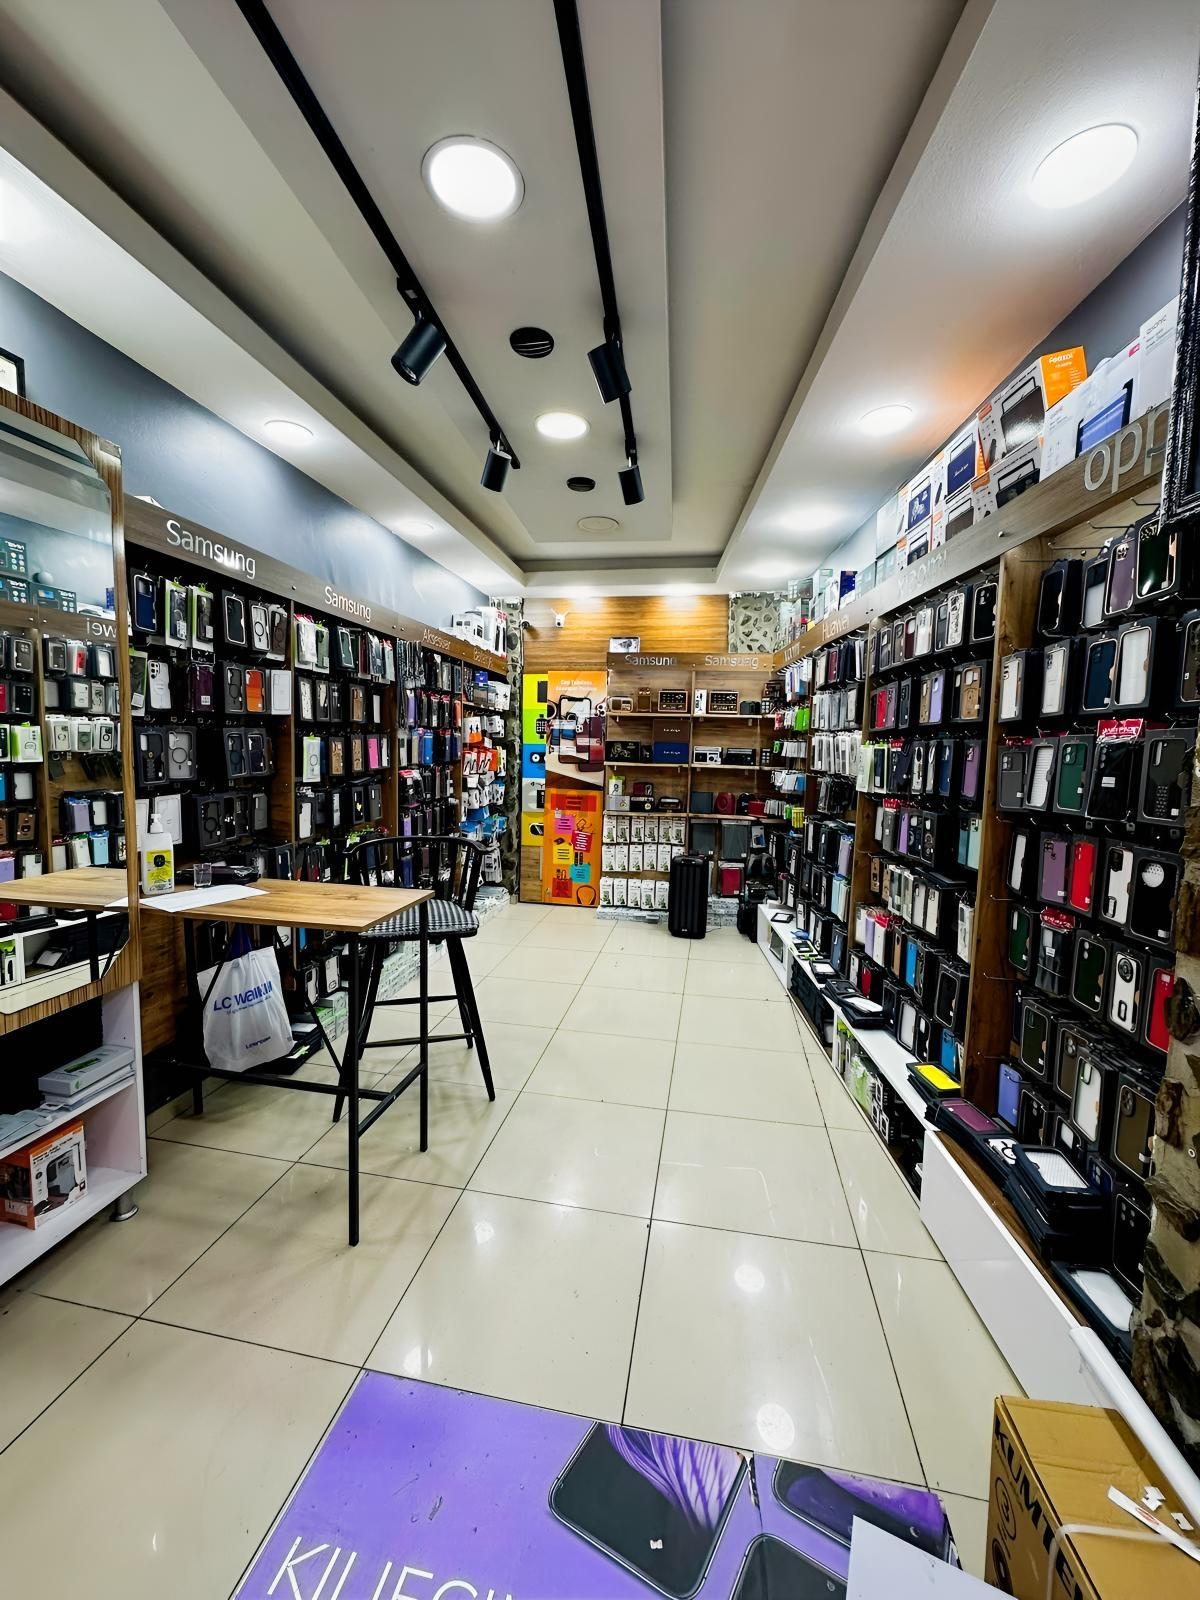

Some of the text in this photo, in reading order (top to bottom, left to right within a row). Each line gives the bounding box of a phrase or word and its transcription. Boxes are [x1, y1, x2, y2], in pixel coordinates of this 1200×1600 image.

[1084, 404, 1171, 494] opp
[166, 519, 256, 579] Samsung
[324, 585, 371, 623] Samsung
[704, 655, 759, 669] Samsung
[213, 996, 232, 1011] LC
[994, 1414, 1084, 1600] KUMTE
